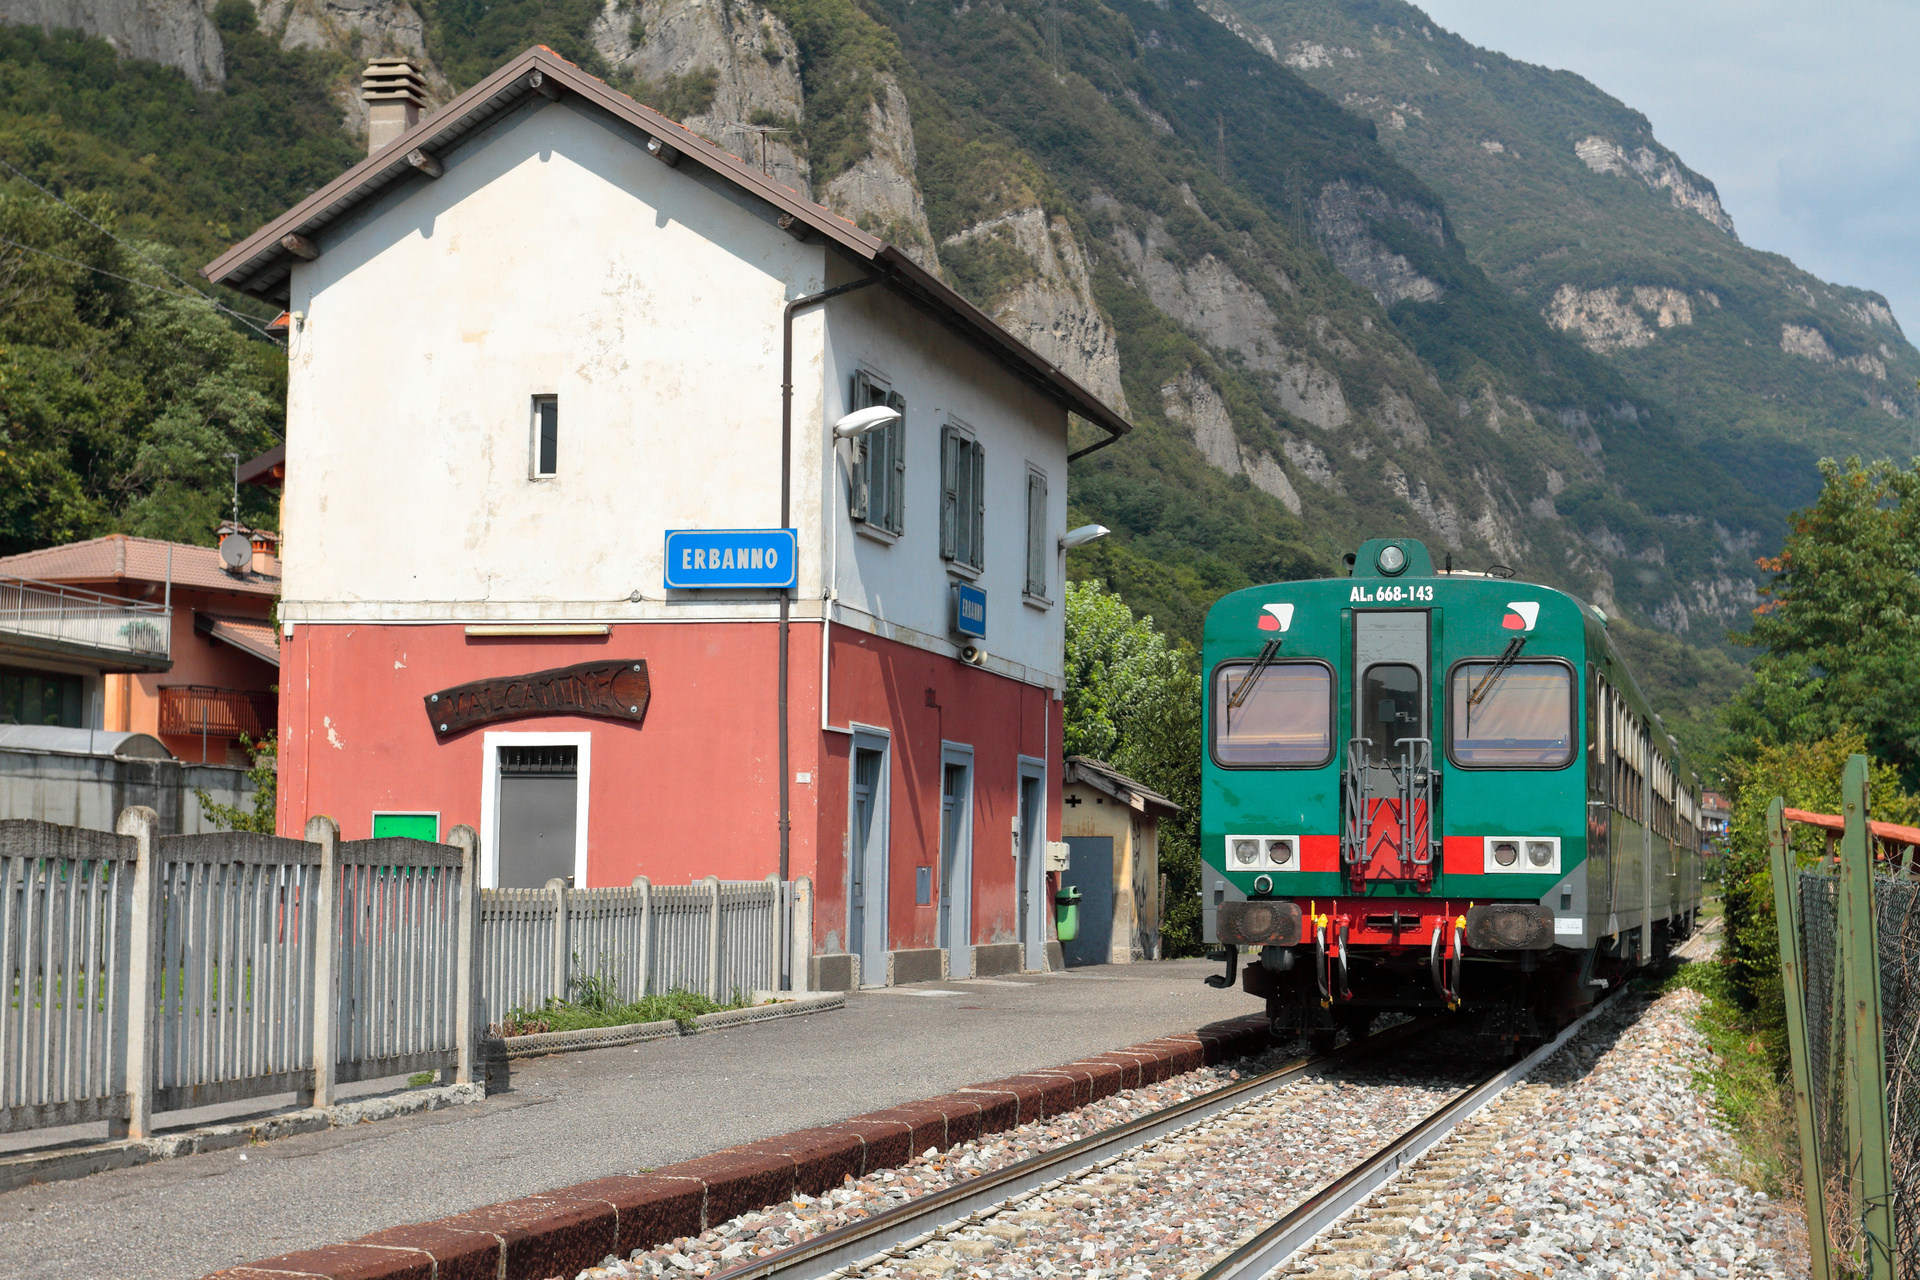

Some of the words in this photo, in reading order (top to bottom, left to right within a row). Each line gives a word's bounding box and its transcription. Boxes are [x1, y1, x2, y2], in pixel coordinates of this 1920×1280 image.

[682, 547, 778, 569] ERBANNO
[1349, 586, 1374, 602] ALn
[1376, 585, 1434, 602] 668-143
[962, 598, 983, 622] ERBANNO
